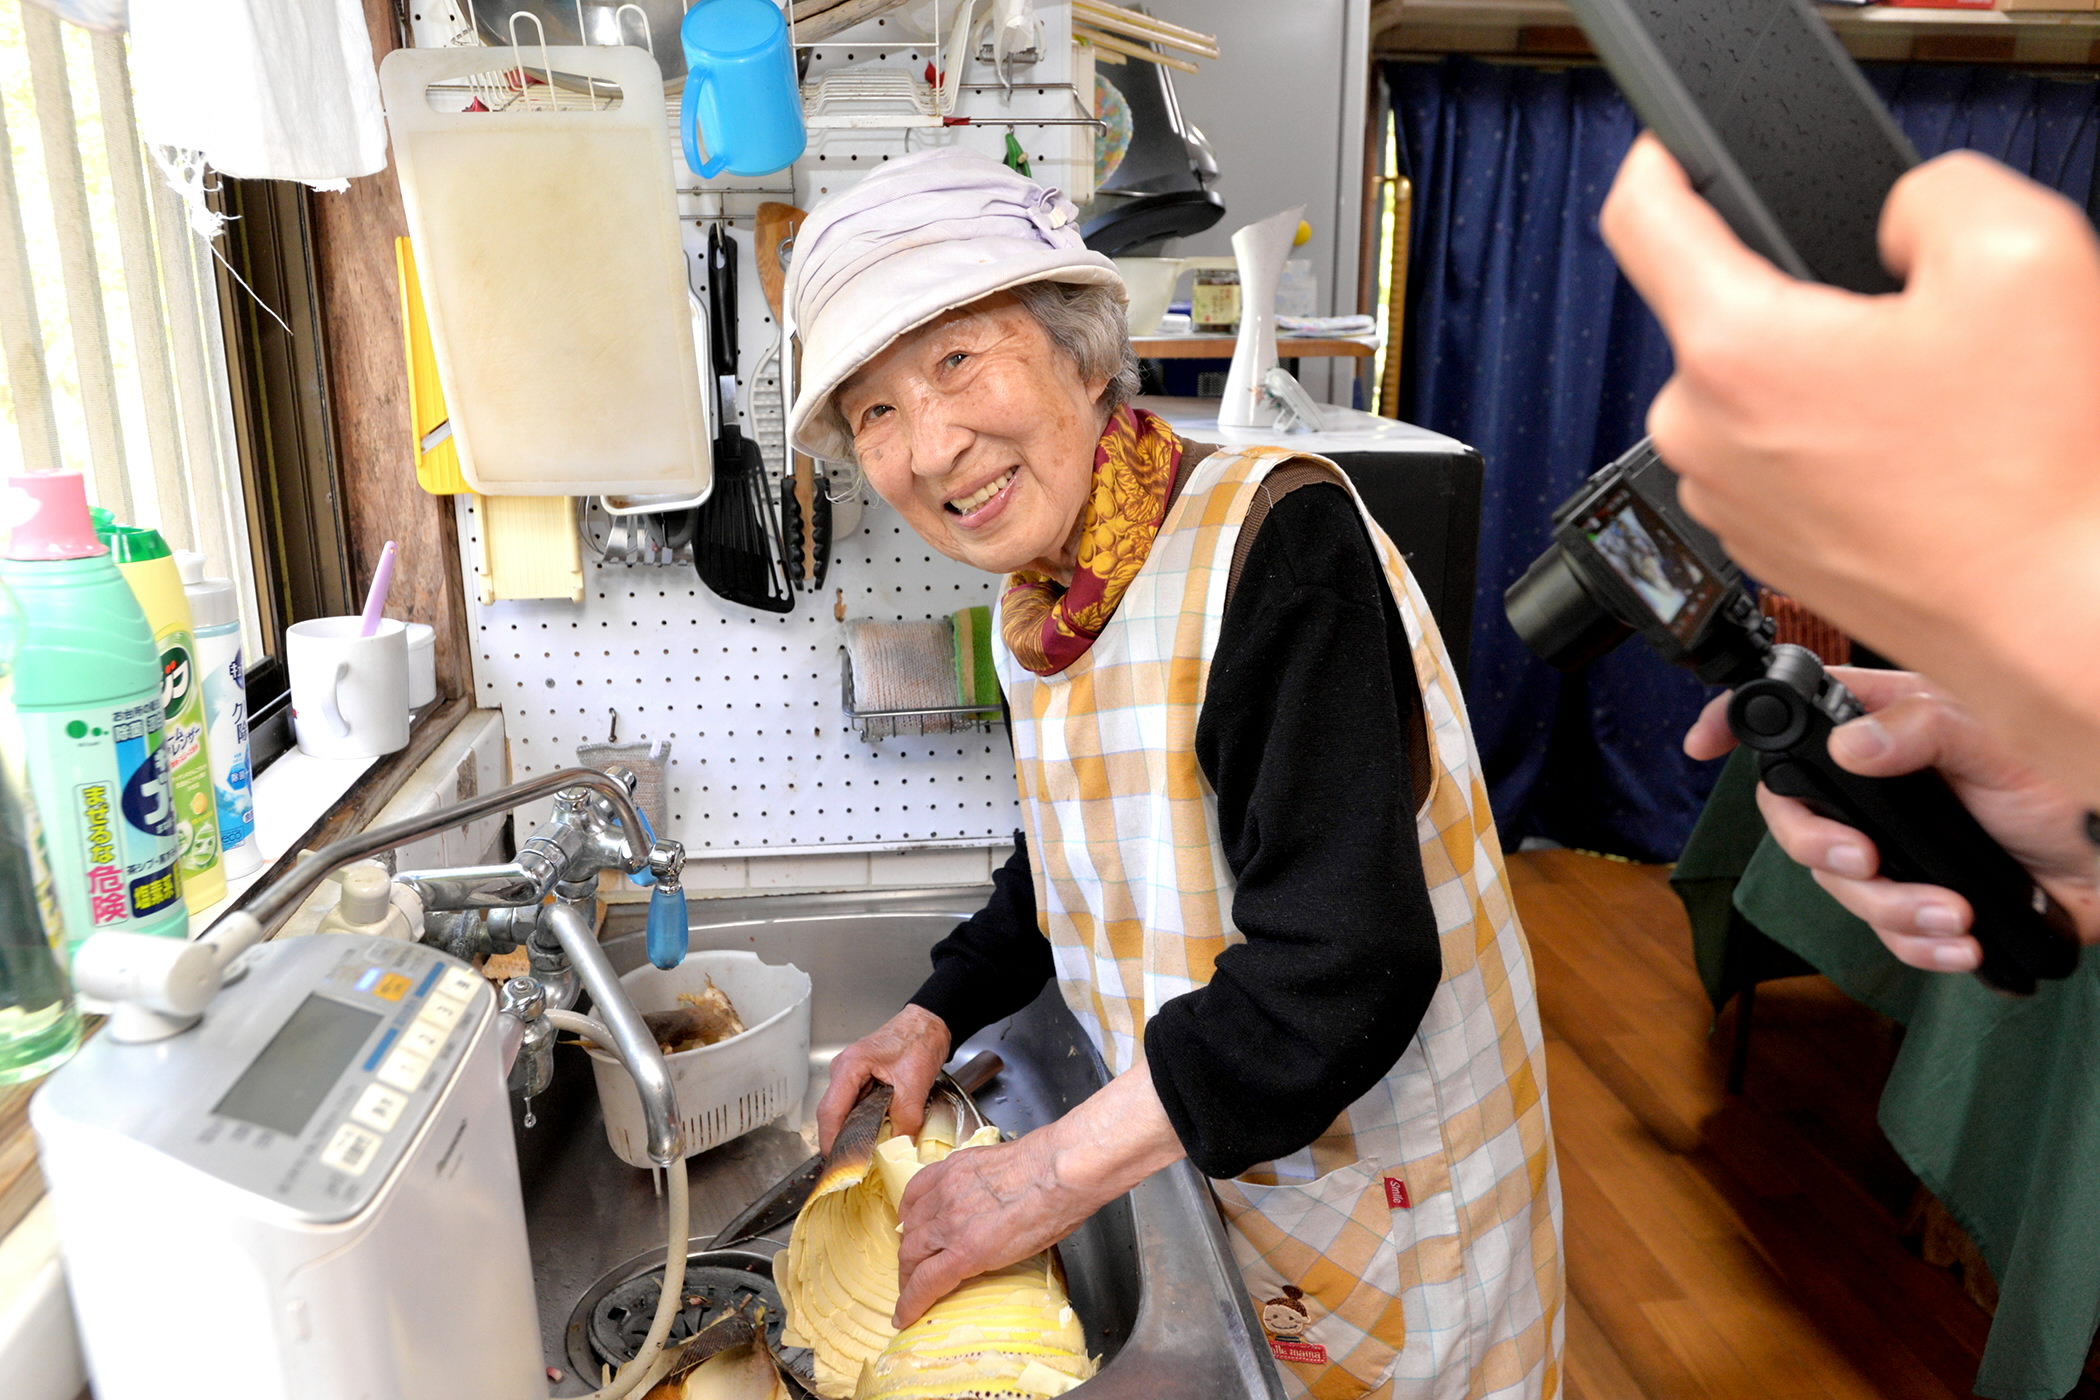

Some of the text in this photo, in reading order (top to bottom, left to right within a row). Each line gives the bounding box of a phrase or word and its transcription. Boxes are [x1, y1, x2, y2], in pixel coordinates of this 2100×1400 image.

[168, 728, 200, 756] レンザー
[82, 785, 128, 926] まぜるな危険
[1390, 1180, 1403, 1204] Smile
[1289, 1348, 1321, 1359] mama
